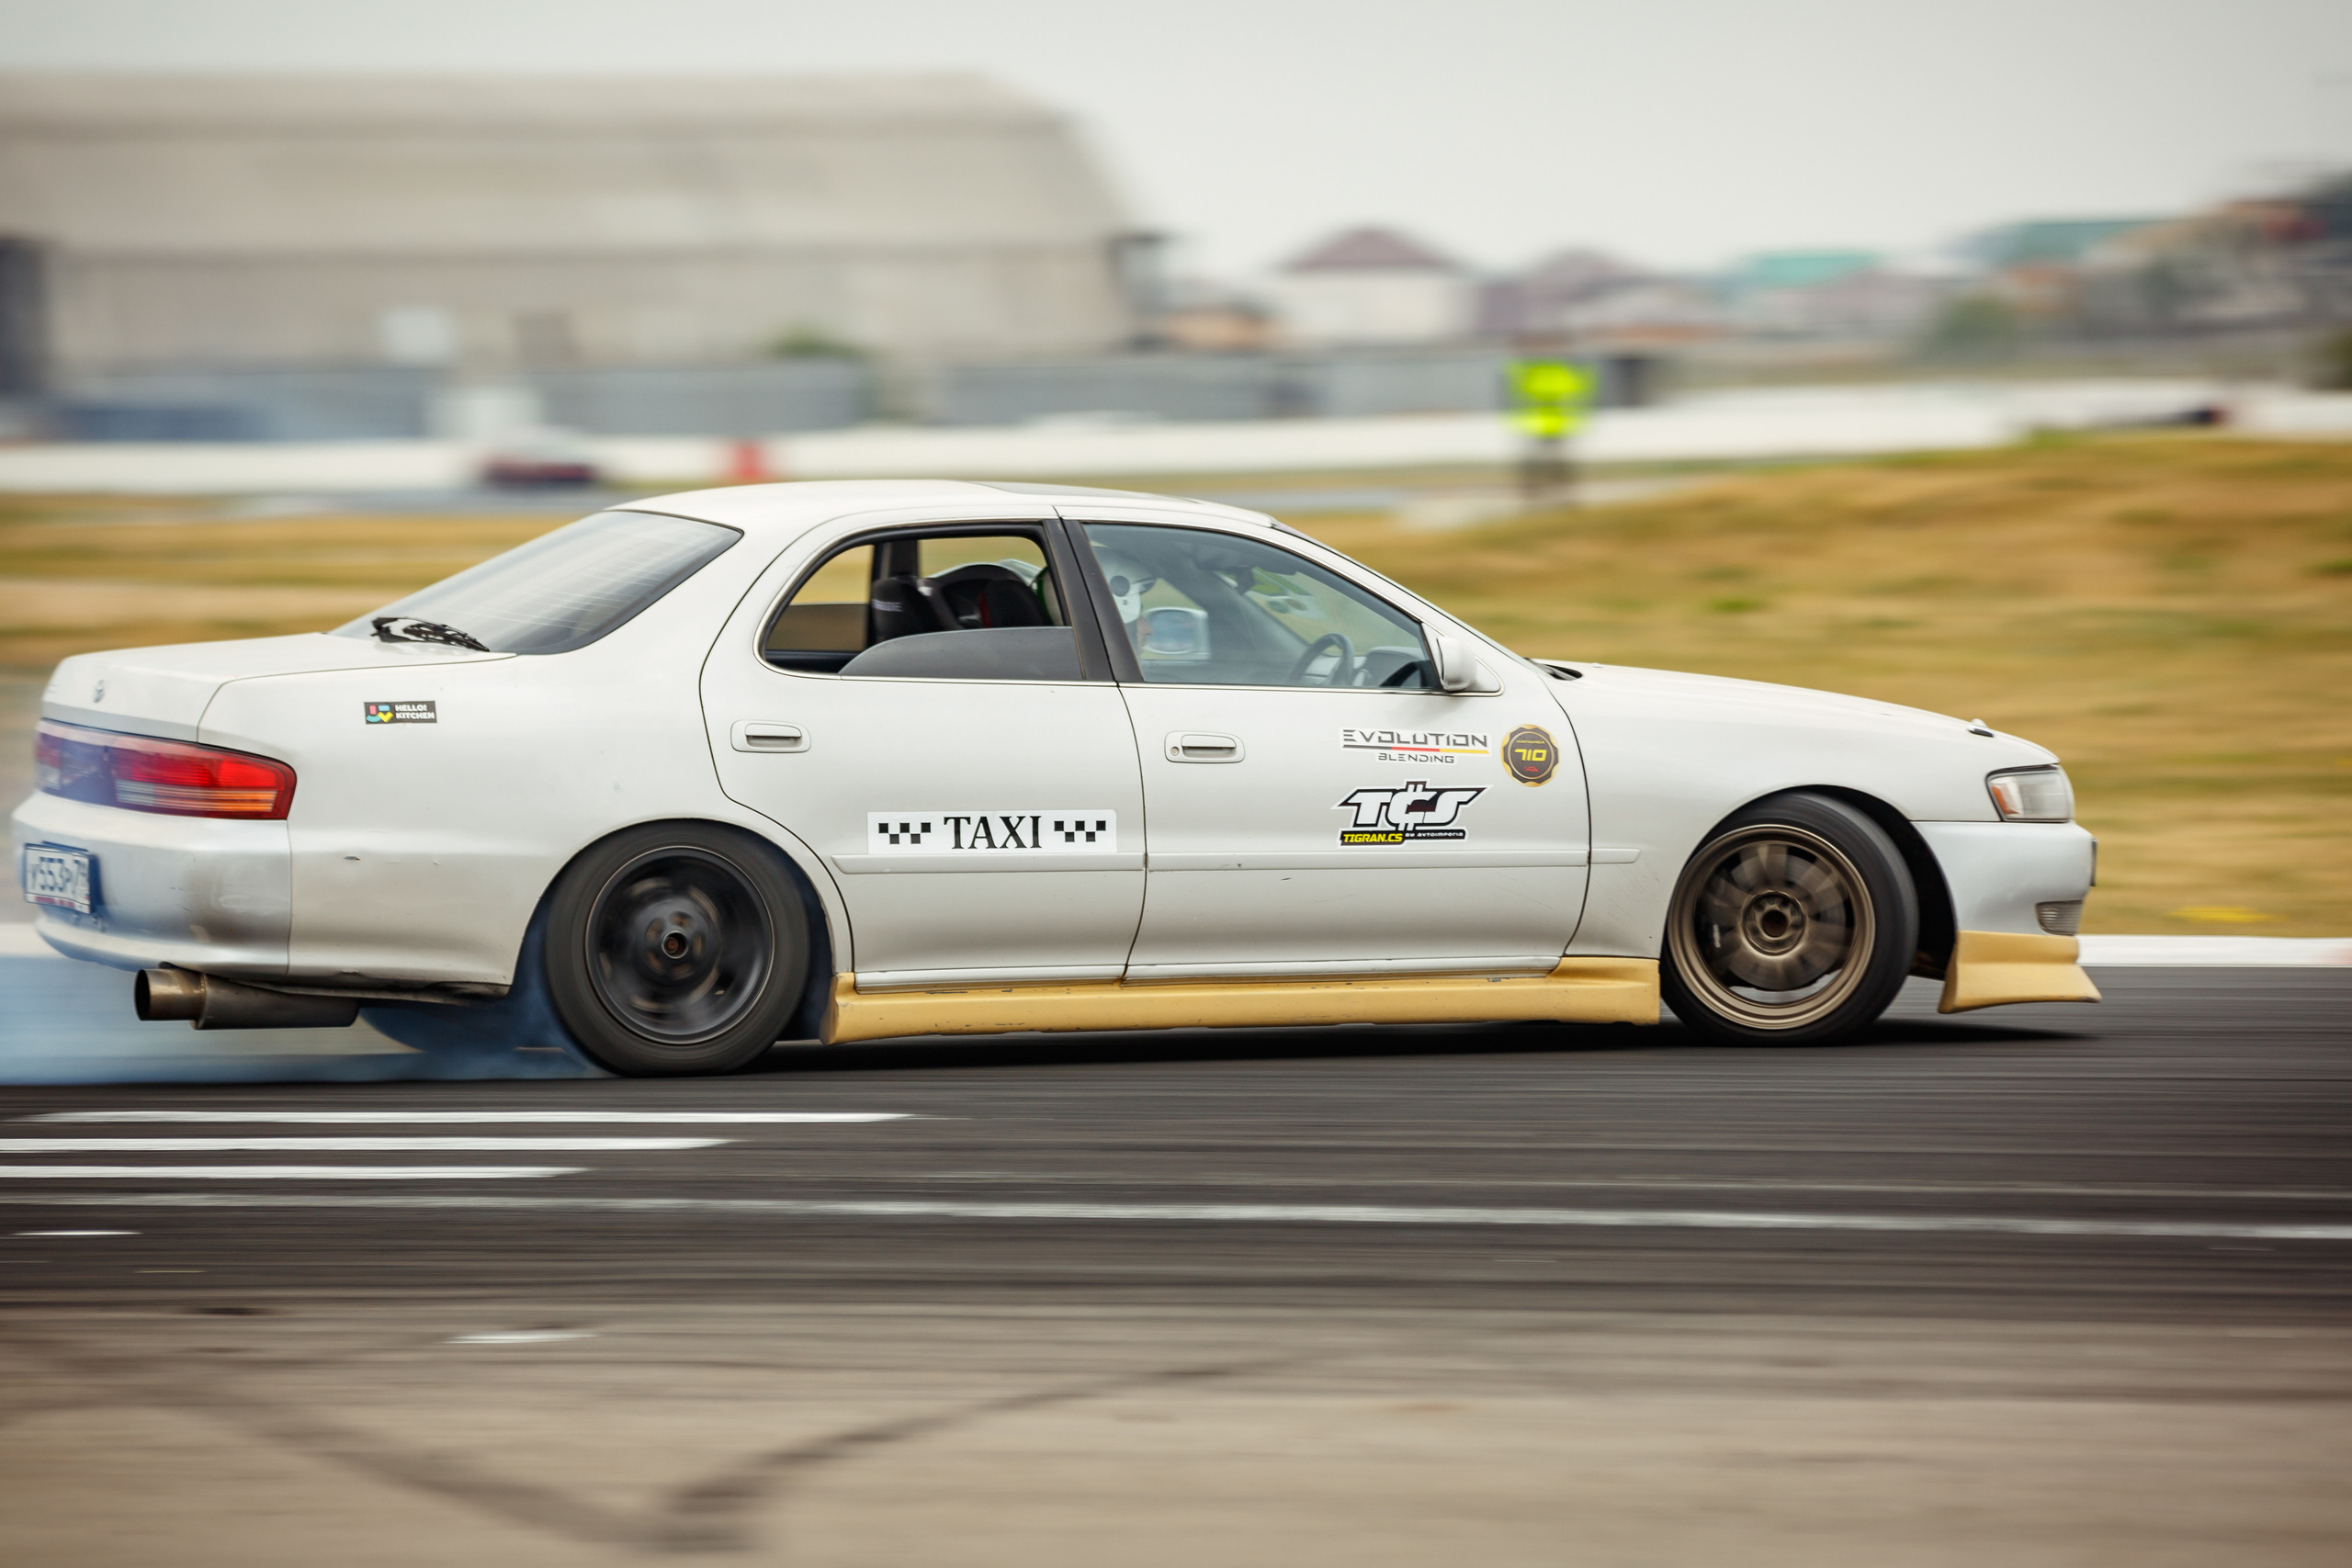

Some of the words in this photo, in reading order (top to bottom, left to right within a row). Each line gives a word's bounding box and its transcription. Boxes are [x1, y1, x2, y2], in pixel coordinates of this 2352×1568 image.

[394, 704, 427, 712] HELLO!
[395, 711, 435, 720] KITCHEN
[1342, 728, 1488, 749] EVOLUTION
[1378, 752, 1455, 764] BLENDING
[1514, 748, 1548, 761] 710
[943, 815, 1043, 850] TAXI
[1343, 832, 1404, 843] TIGRAN.CS
